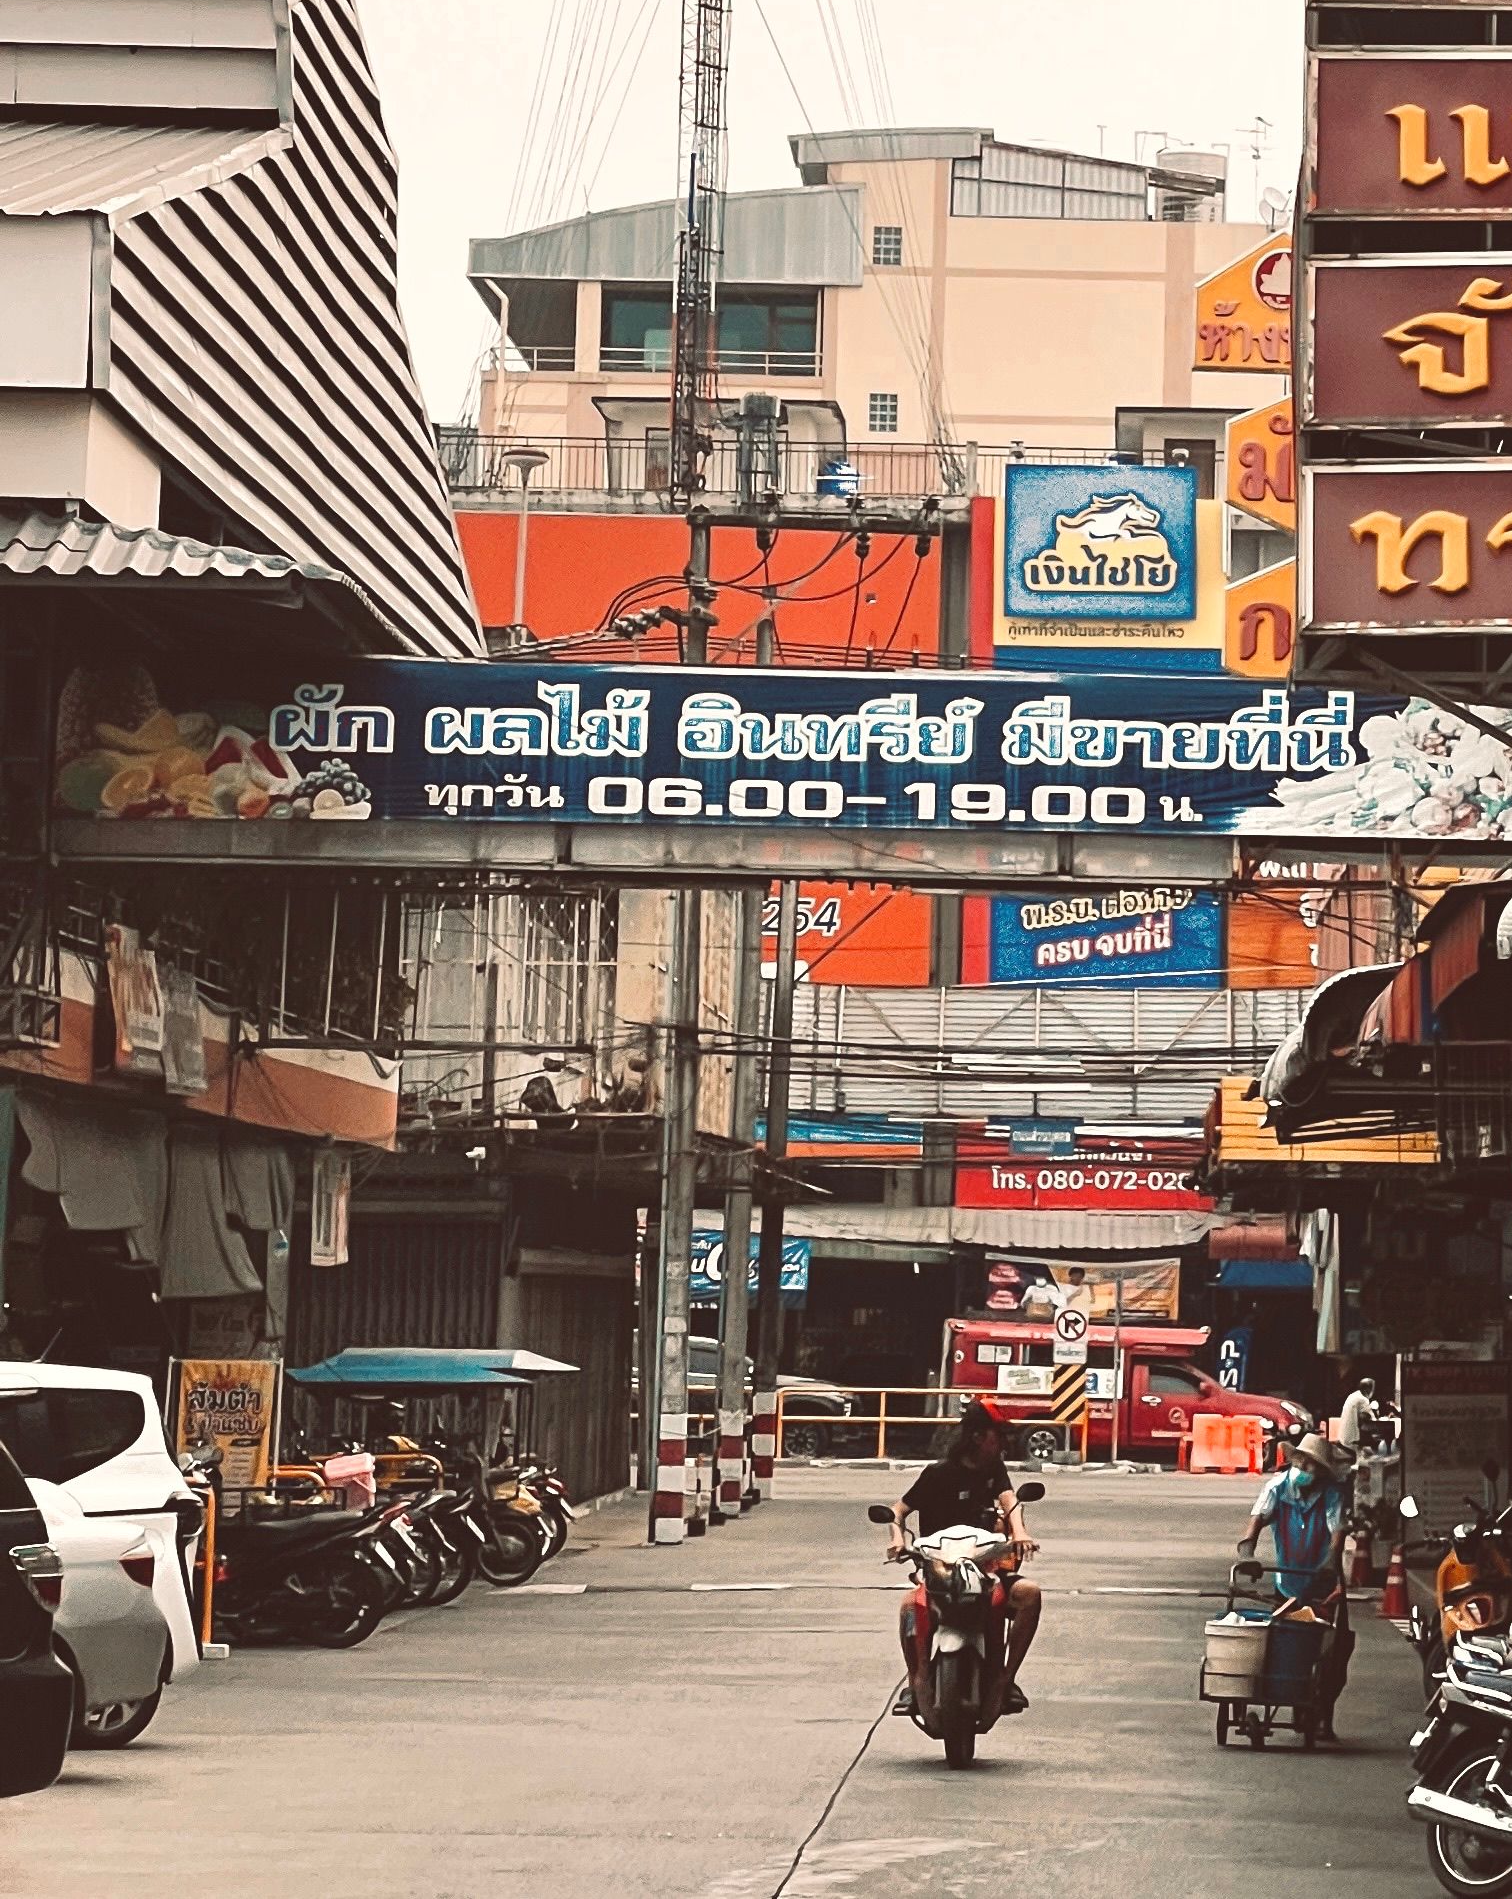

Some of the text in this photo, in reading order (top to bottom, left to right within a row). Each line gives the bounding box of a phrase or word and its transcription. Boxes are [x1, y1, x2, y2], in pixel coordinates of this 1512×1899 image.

[1030, 545, 1172, 587] เงินไชโย
[269, 683, 1357, 773] ผัก ผลไม้ อินทรีย์ มีขายที่นี่
[423, 775, 565, 817] ทุกวัน
[1160, 794, 1204, 823] น.
[1037, 938, 1091, 967] ครบ
[992, 1165, 1032, 1190] โทร.
